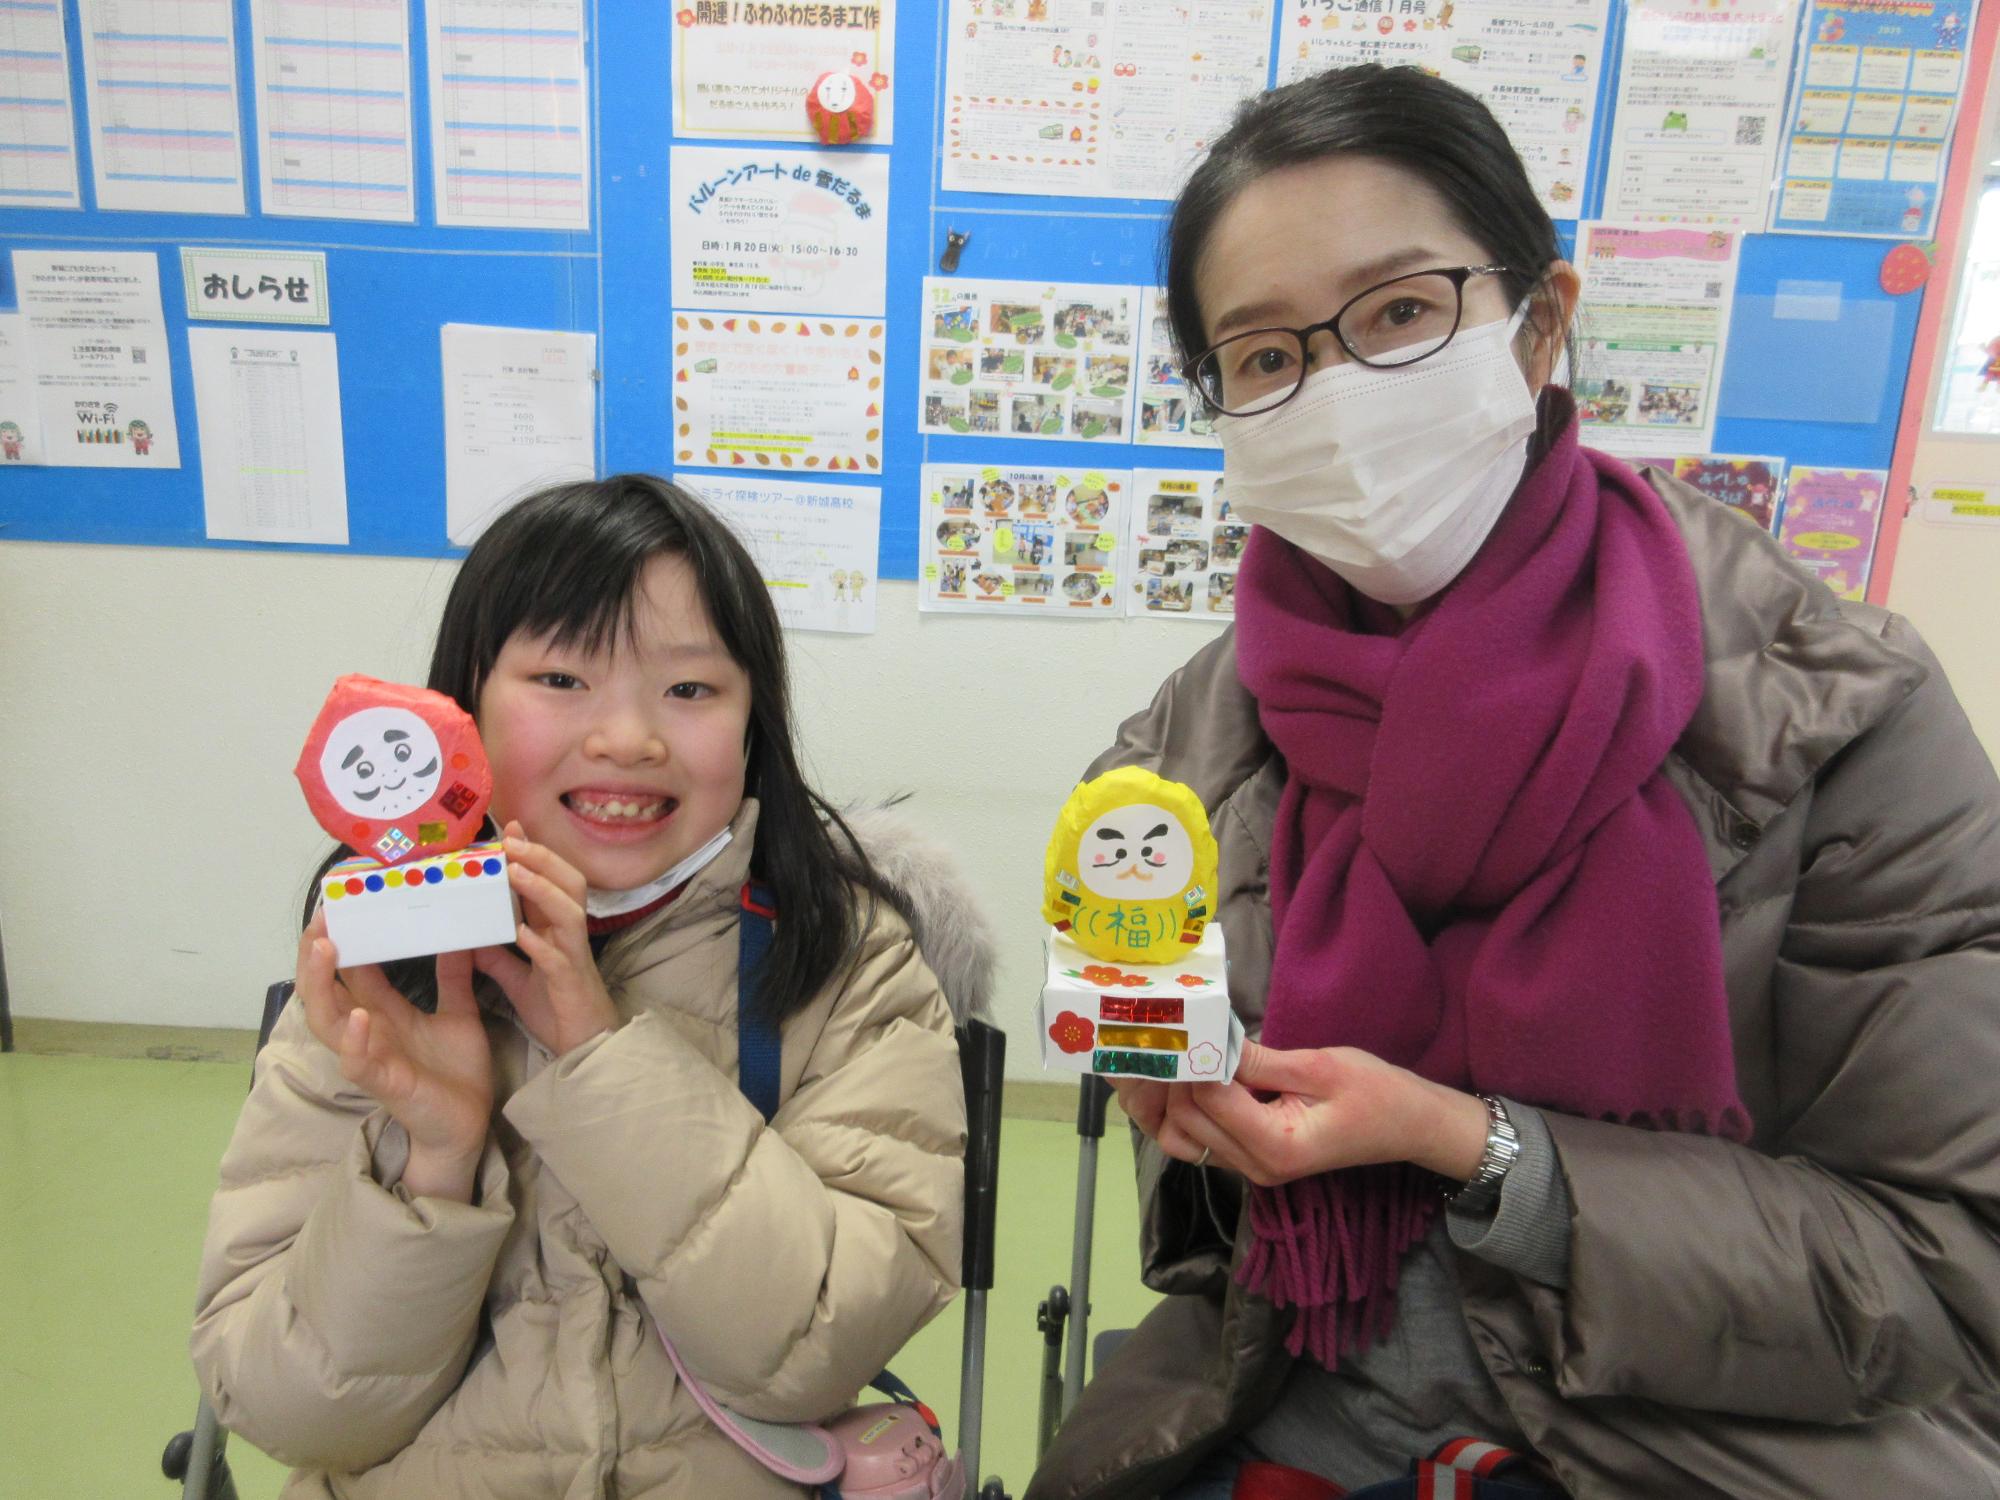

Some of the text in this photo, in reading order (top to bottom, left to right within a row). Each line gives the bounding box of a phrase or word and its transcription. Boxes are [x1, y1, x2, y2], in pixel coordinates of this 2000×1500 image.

[688, 162, 873, 222] バルーンアート de 雪だるま
[202, 272, 310, 305] おしらせ
[77, 413, 116, 425] Wi-Fi
[1105, 902, 1152, 949] 福
